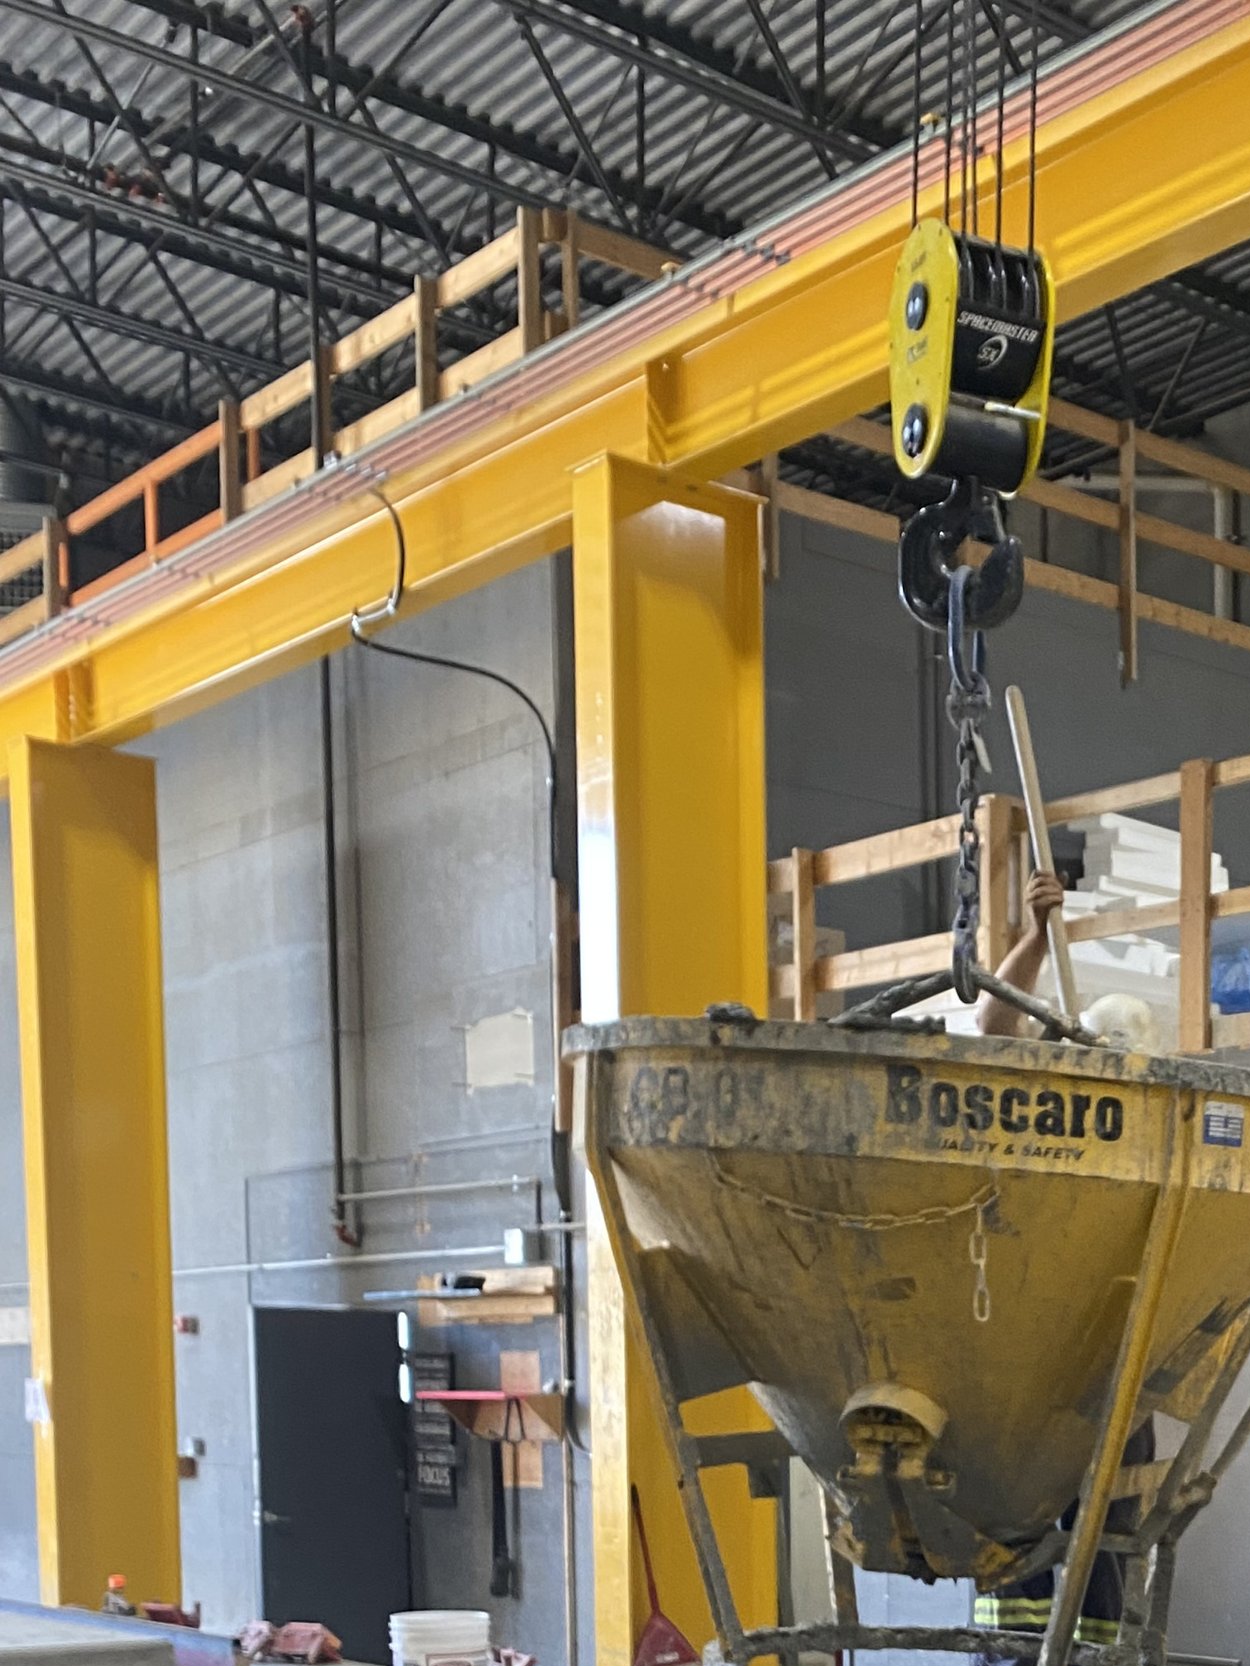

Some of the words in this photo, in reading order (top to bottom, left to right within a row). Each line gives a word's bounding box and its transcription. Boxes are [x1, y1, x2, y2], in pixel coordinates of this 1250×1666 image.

[957, 310, 1039, 343] SPACEMASTER
[884, 1063, 1125, 1142] Boscaro
[1003, 1144, 1015, 1155] &
[1022, 1144, 1086, 1160] SAFETY
